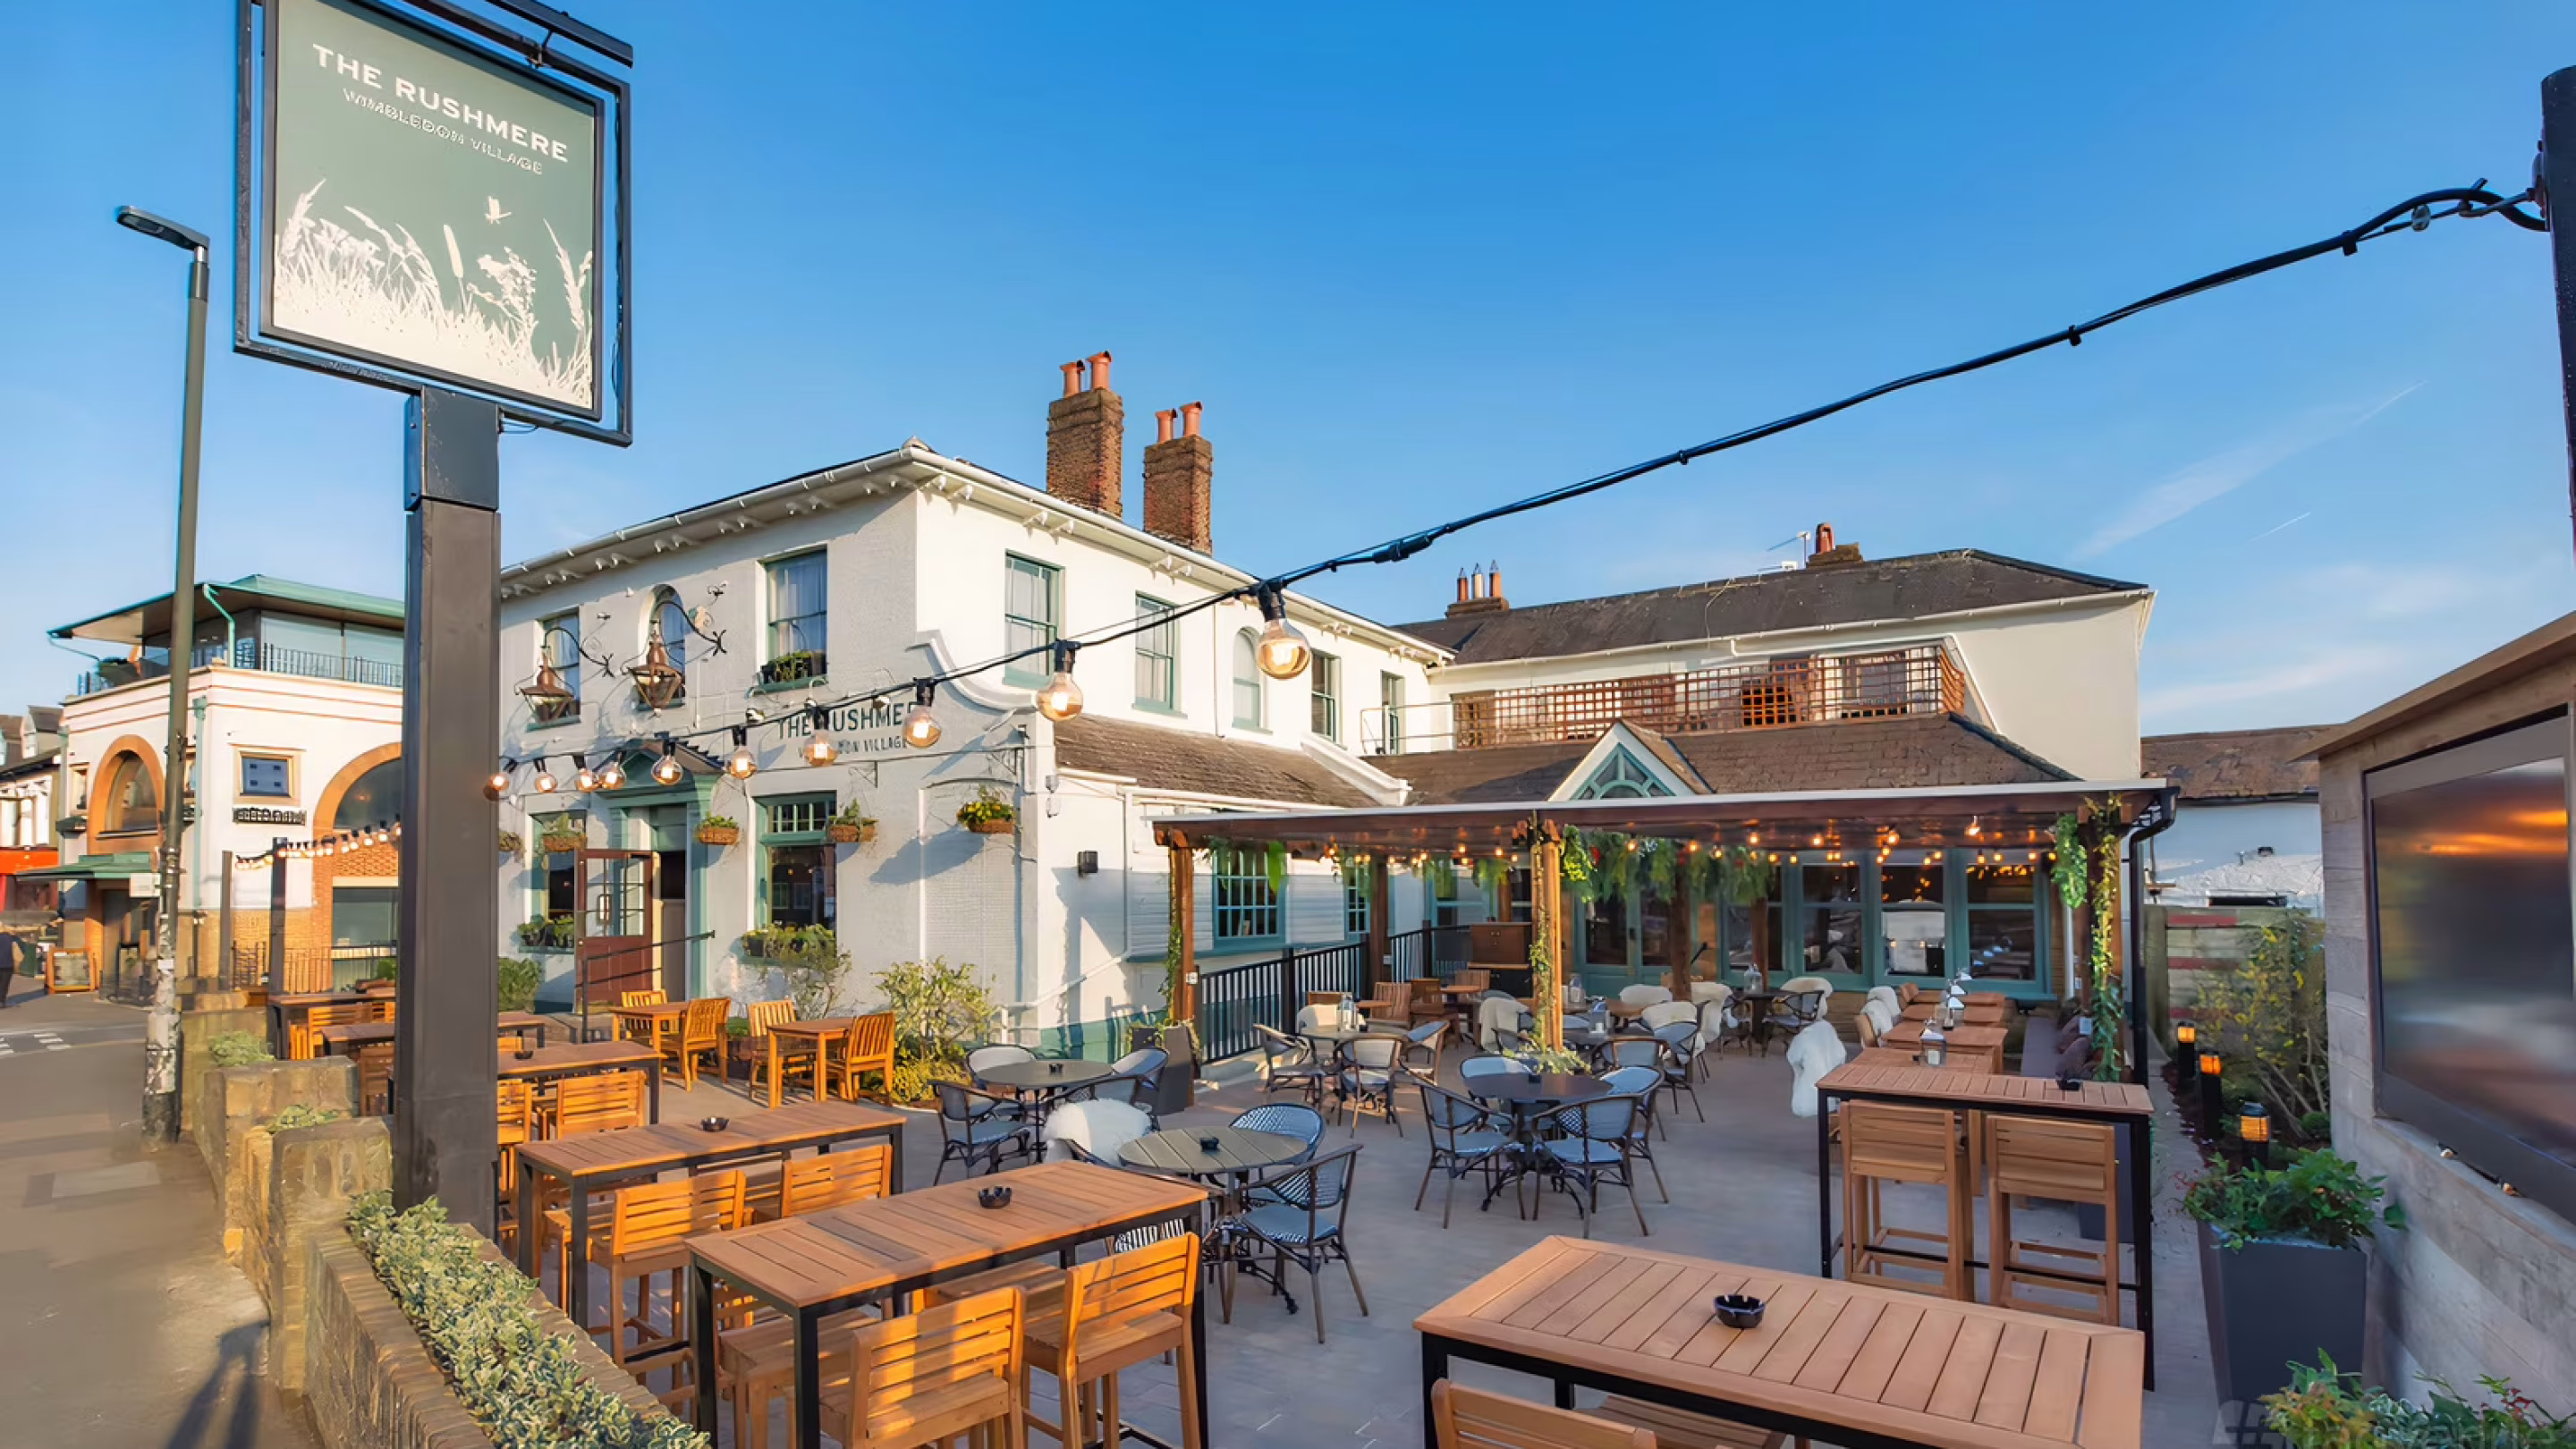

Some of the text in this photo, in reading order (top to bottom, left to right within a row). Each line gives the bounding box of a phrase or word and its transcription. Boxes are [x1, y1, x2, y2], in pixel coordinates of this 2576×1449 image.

[312, 43, 569, 163] THE RUSHMERE
[342, 87, 543, 175] WIMBLEDON VILLAGE
[778, 700, 926, 740] THE USHME
